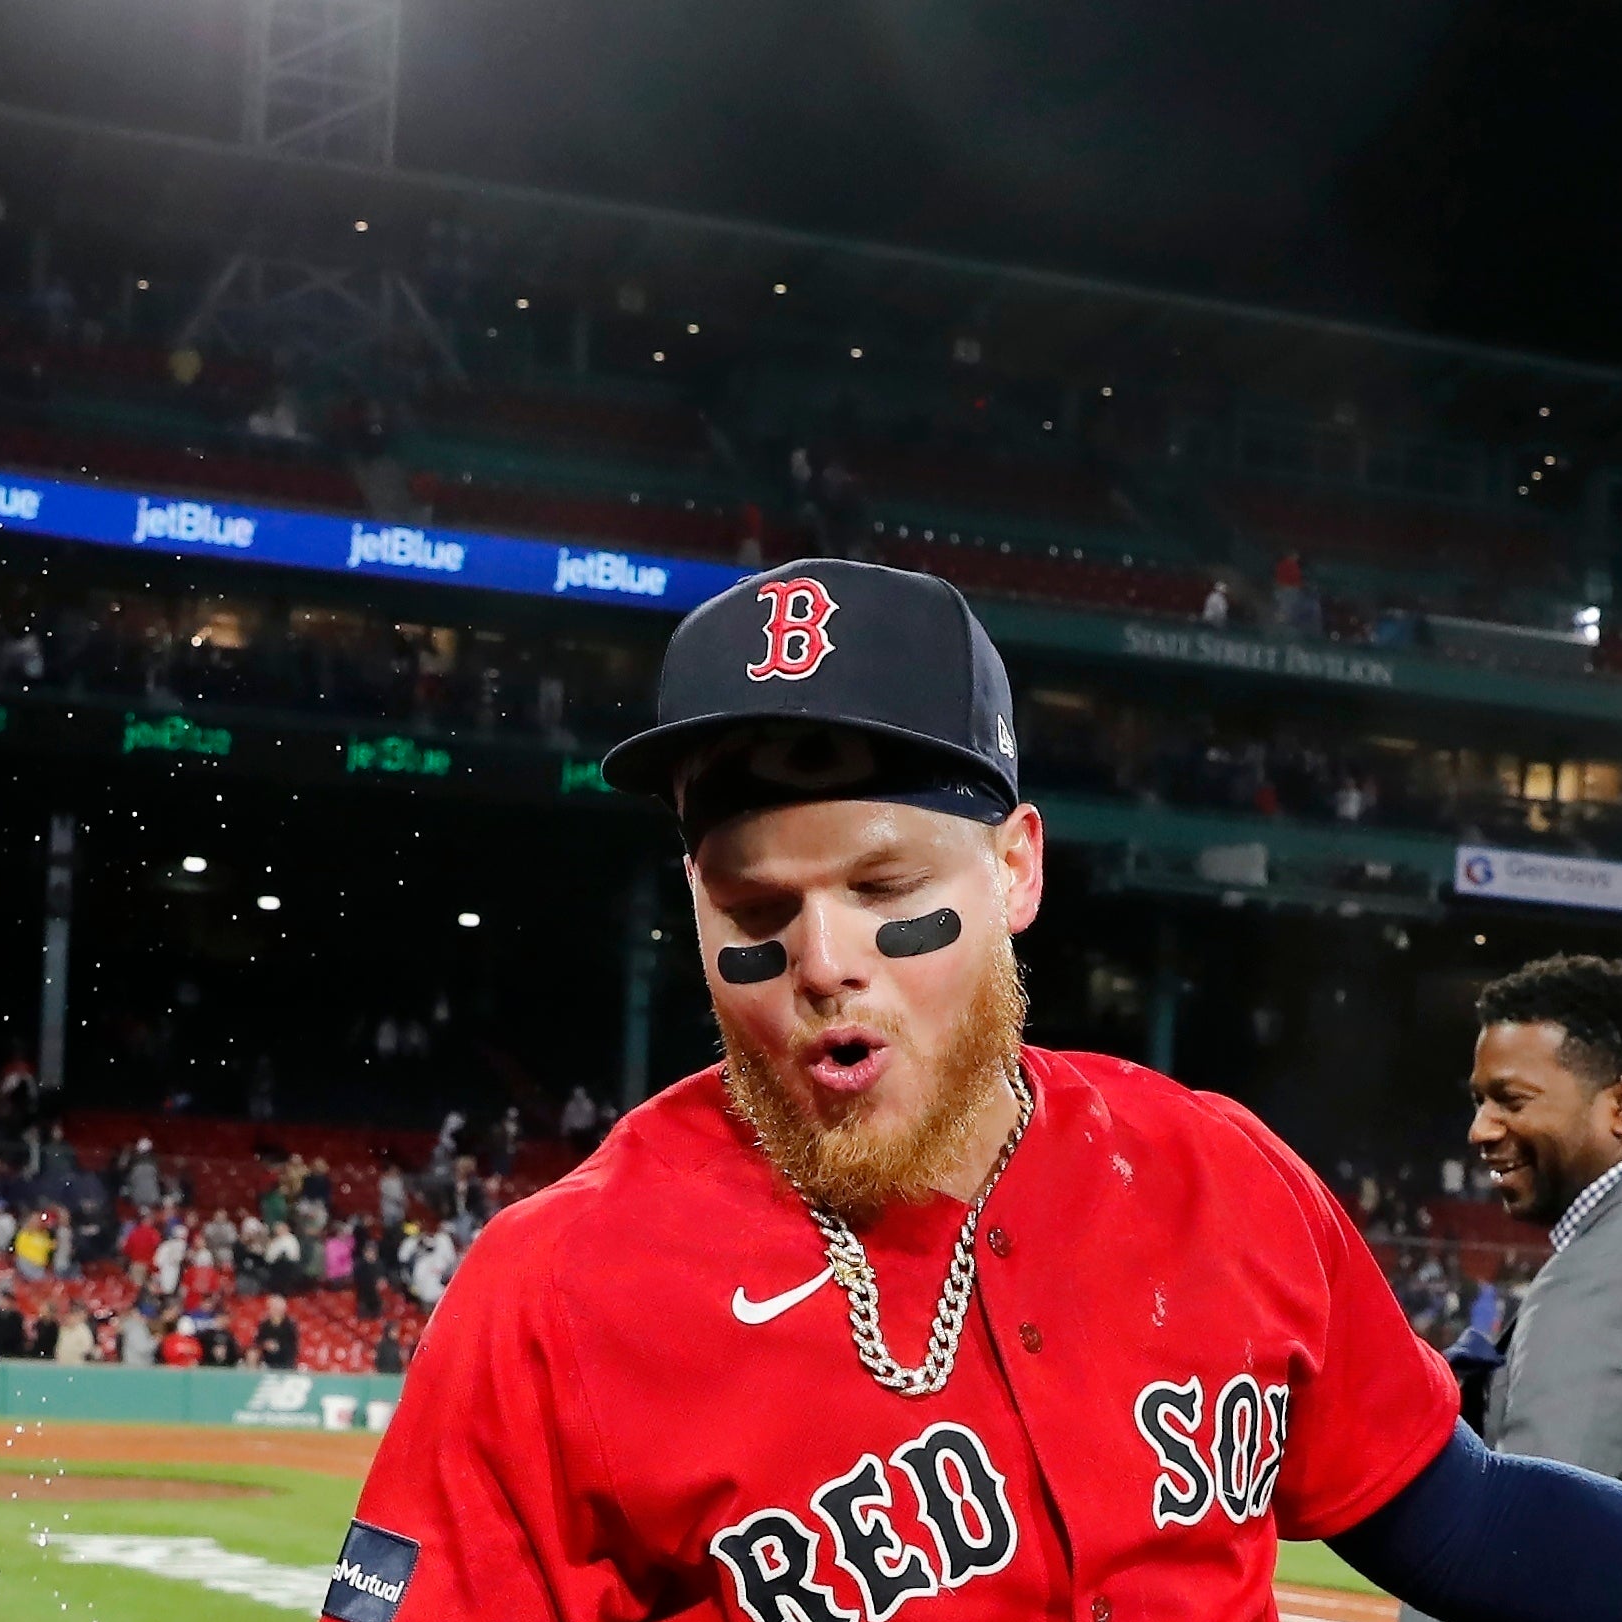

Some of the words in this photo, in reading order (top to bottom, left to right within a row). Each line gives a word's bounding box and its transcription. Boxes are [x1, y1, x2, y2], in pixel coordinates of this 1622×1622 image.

[133, 496, 257, 549] jetBlue
[347, 523, 466, 573] jetBlue
[554, 547, 669, 597] jetBlue
[746, 576, 840, 682] B
